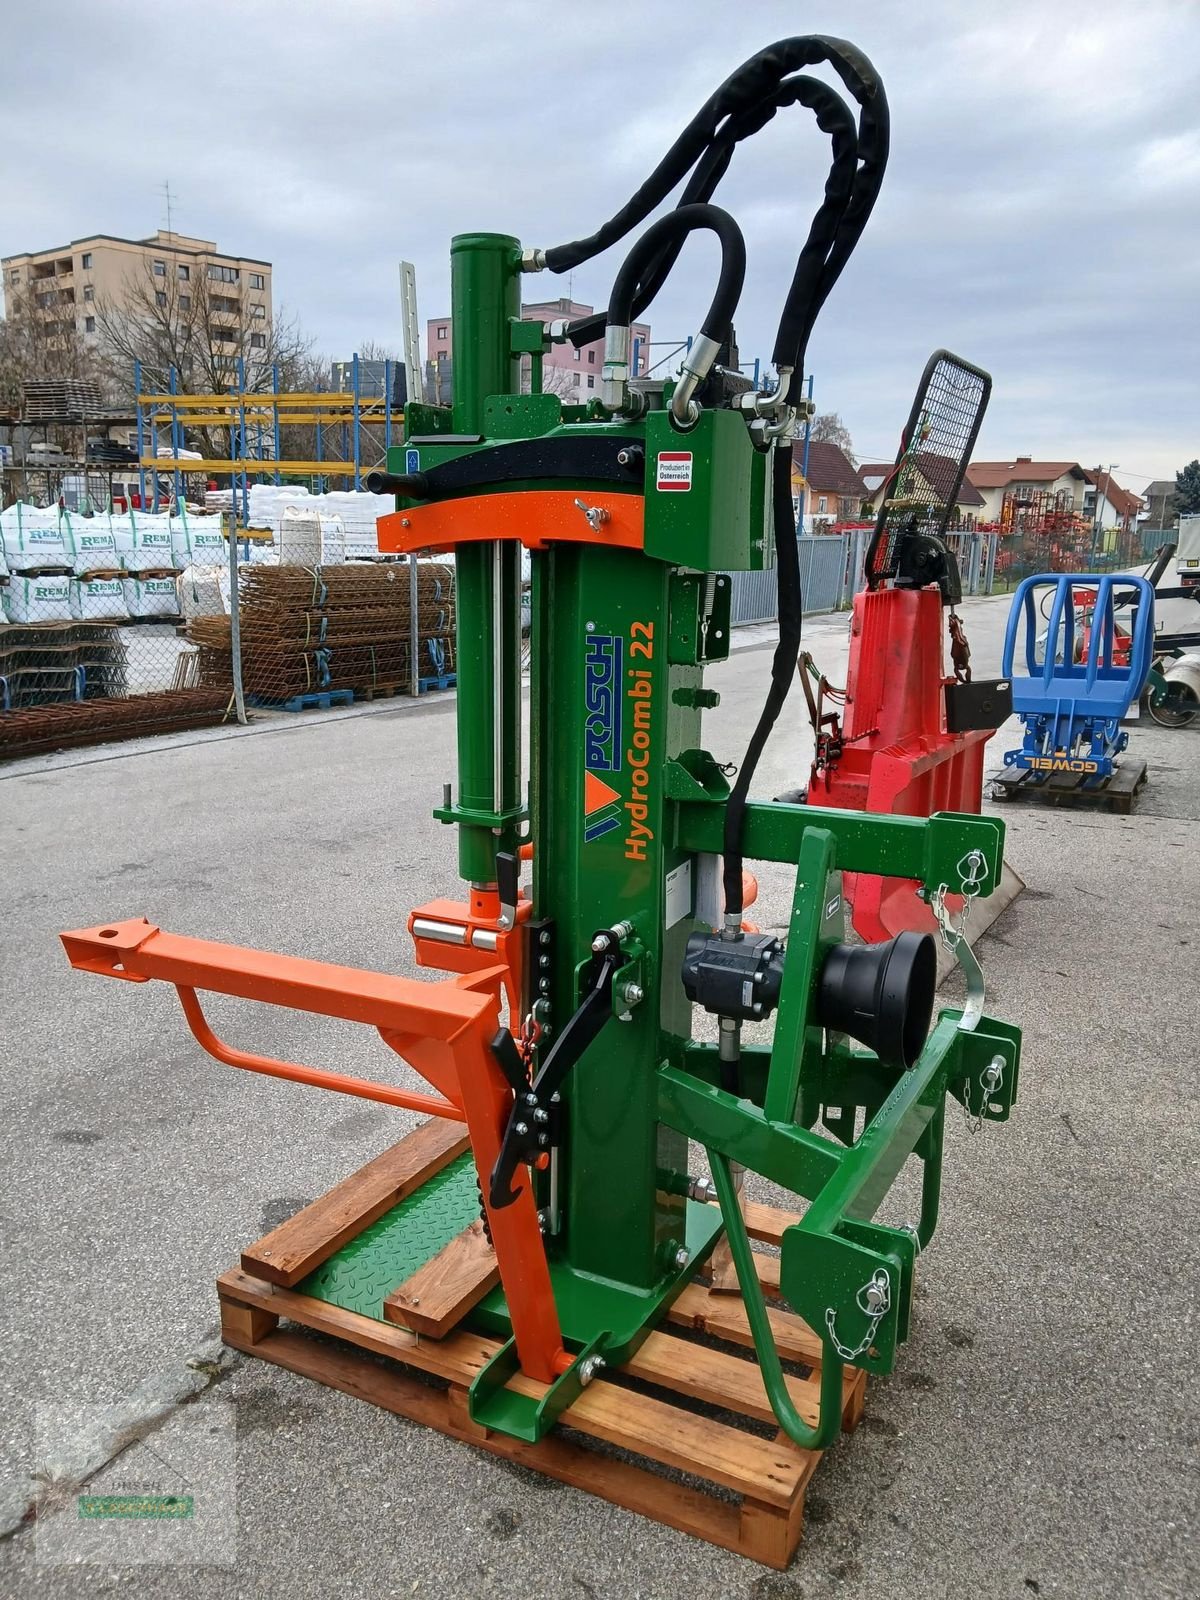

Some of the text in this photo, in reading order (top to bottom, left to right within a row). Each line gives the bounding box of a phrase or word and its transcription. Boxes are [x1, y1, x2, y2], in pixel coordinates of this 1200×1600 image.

[81, 535, 114, 546] REMA
[142, 534, 171, 544] REMA
[194, 534, 223, 544] REMA
[35, 586, 69, 598] REMA
[87, 582, 122, 593] REMA
[585, 635, 613, 770] POSCH
[624, 621, 654, 860] HydroCombi 22
